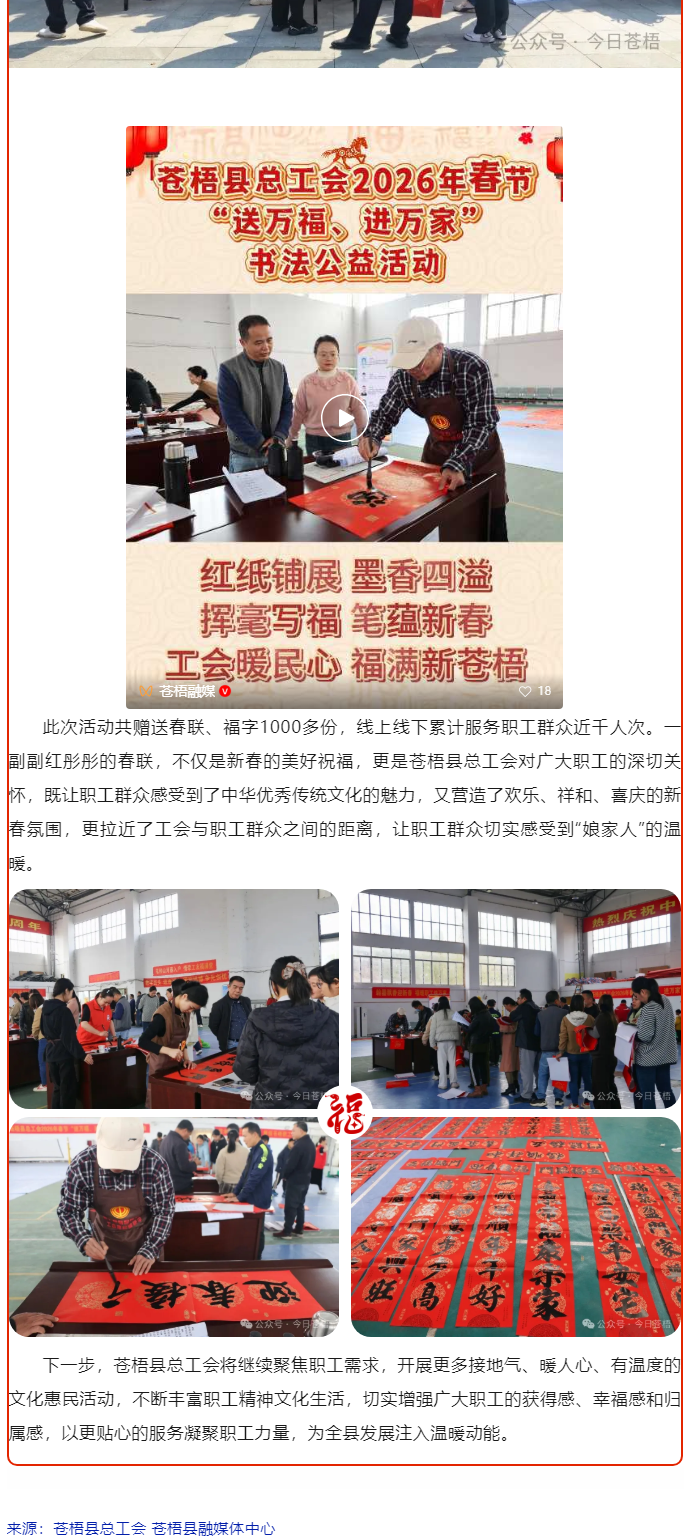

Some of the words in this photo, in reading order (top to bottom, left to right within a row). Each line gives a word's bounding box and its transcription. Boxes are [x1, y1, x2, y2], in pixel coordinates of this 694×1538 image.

[156, 158, 535, 197] 苍梧县总工会2026年春节
[211, 205, 478, 237] “送万福、进万家”
[248, 248, 442, 278] 书法公益活动
[200, 558, 341, 593] 红纸铺展
[351, 558, 493, 593] 墨香四溢
[200, 603, 341, 638] 挥毫写福
[351, 603, 493, 638] 笔蕴新春
[165, 648, 341, 683] 工会暖民心
[351, 648, 528, 683] 福满新苍梧
[9, 917, 42, 931] 周年
[592, 900, 676, 928] 热烈庆祝中
[6, 1521, 147, 1536] 来源：苍梧县总工会
[151, 1521, 276, 1536] 苍梧县融媒体中心
